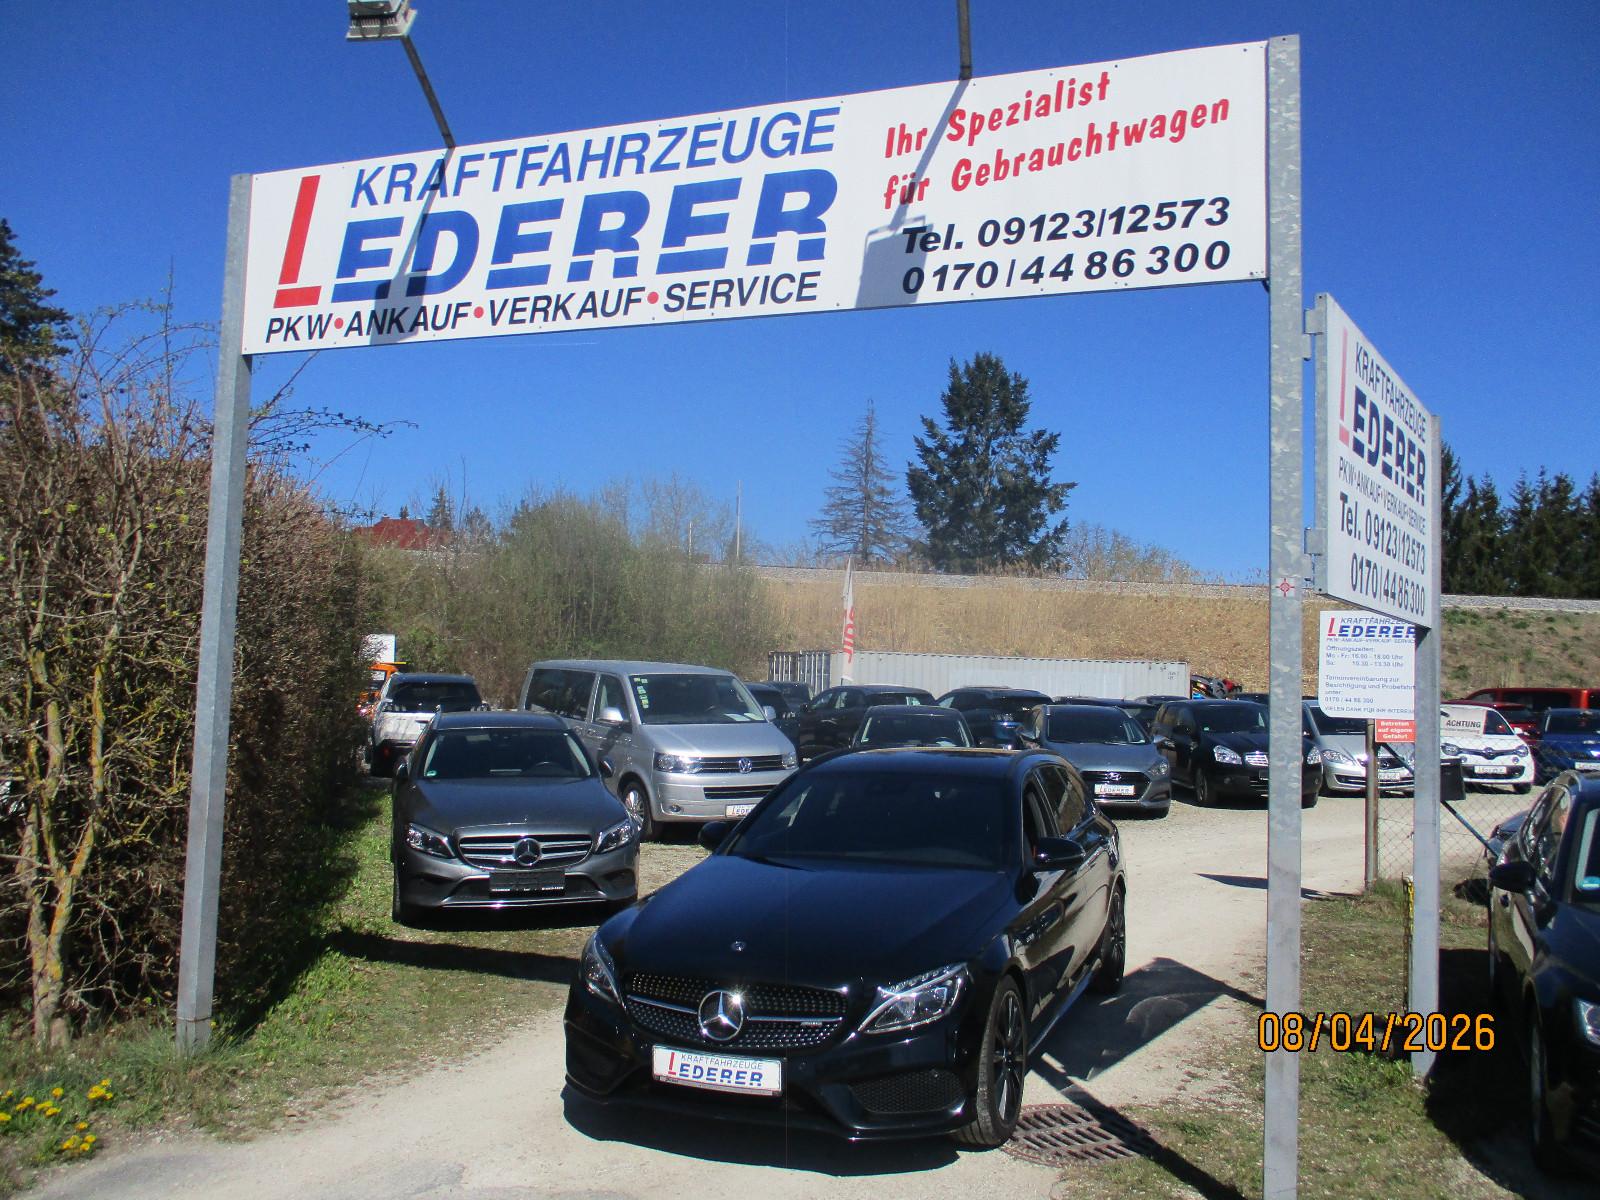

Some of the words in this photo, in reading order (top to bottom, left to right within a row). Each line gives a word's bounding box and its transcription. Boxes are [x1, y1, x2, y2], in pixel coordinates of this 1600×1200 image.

[884, 126, 928, 158] Ihr
[947, 71, 1111, 147] Spezialist
[350, 107, 842, 208] KRAFTFAHRZEUGE
[884, 172, 930, 209] für
[950, 98, 1230, 192] Gebrauchtwagen
[273, 168, 838, 309] LEDERER
[902, 223, 964, 254] Tel.
[1145, 240, 1231, 275] 300
[664, 271, 822, 313] SERVICE
[1355, 342, 1426, 443] KRAFTFAHRZEUGE
[1339, 326, 1426, 507] LEDERER
[1340, 490, 1361, 541] Tel.
[1410, 580, 1425, 617] 300
[1446, 719, 1481, 728] ACHTUNG
[667, 1051, 764, 1087] LEDERER
[680, 1053, 765, 1071] KRAFTFAHRZEUGE
